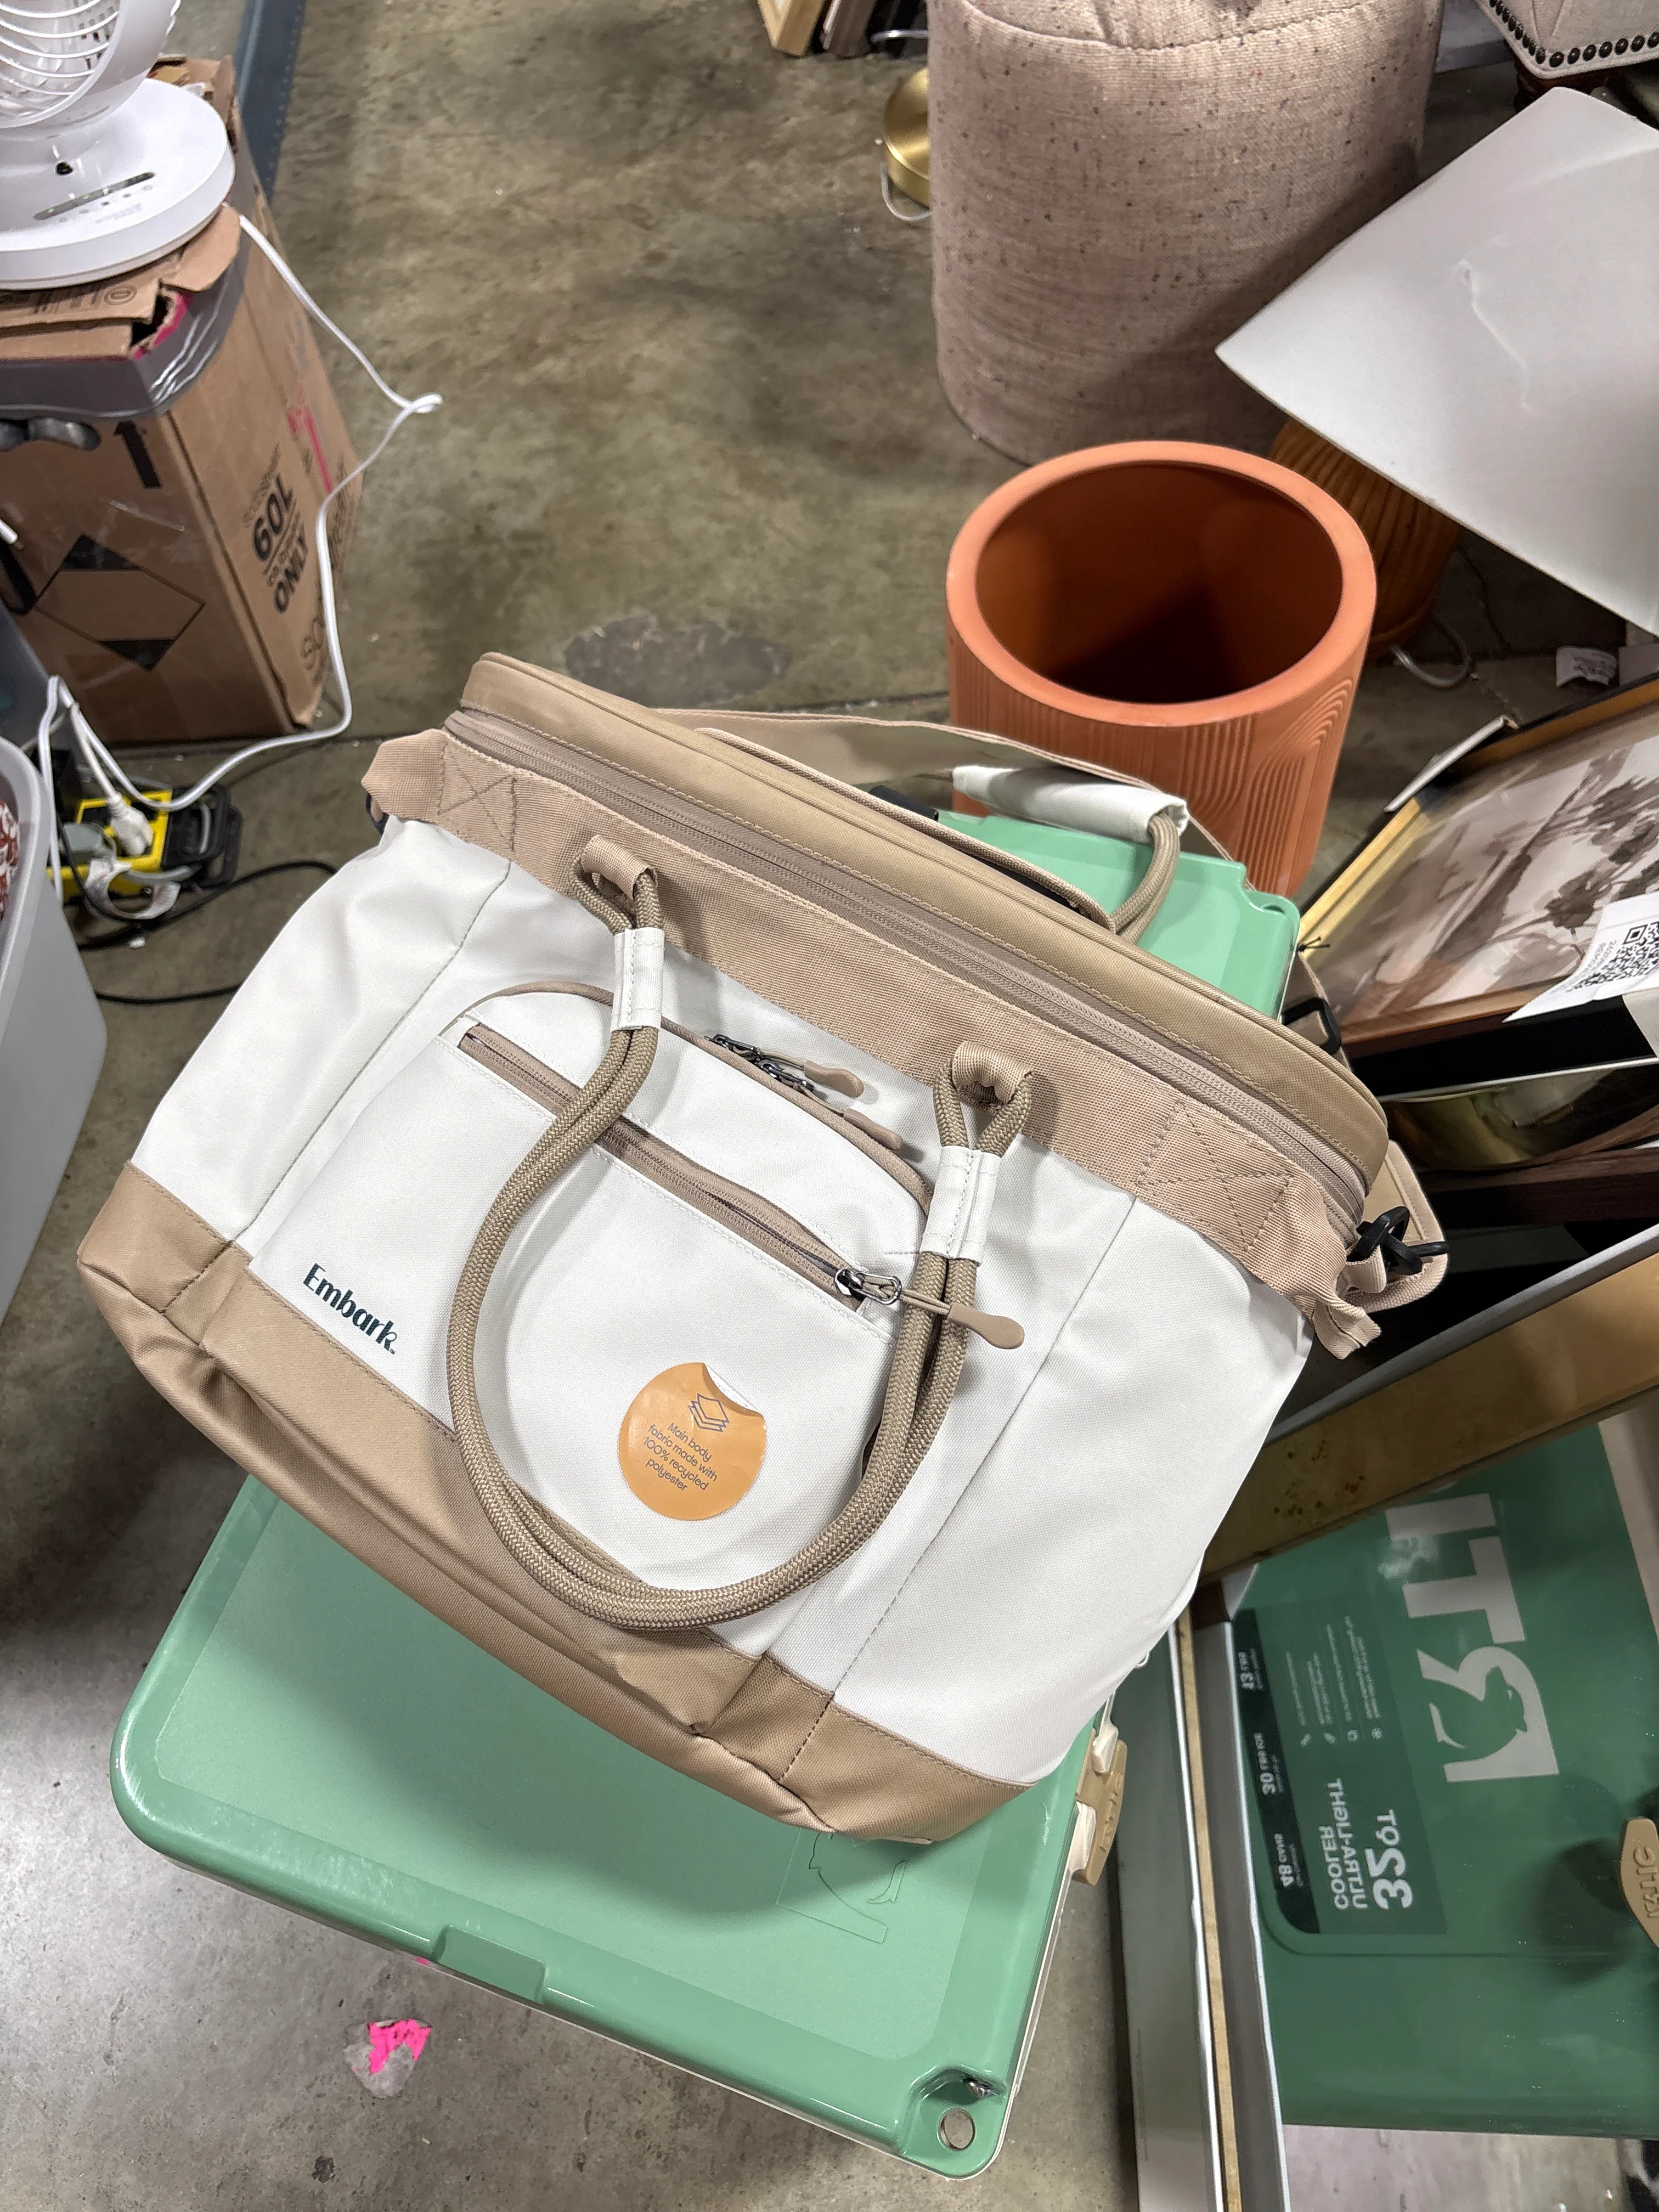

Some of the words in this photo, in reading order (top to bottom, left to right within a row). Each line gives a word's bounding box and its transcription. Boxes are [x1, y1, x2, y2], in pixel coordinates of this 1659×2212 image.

[643, 1437, 671, 1462] 100%
[669, 1458, 709, 1491] recycled
[647, 1424, 673, 1447] fabric
[672, 1444, 698, 1466] made
[698, 1463, 718, 1482] with
[667, 1422, 689, 1443] Main
[687, 1437, 712, 1463] body
[645, 1458, 688, 1491] polyester
